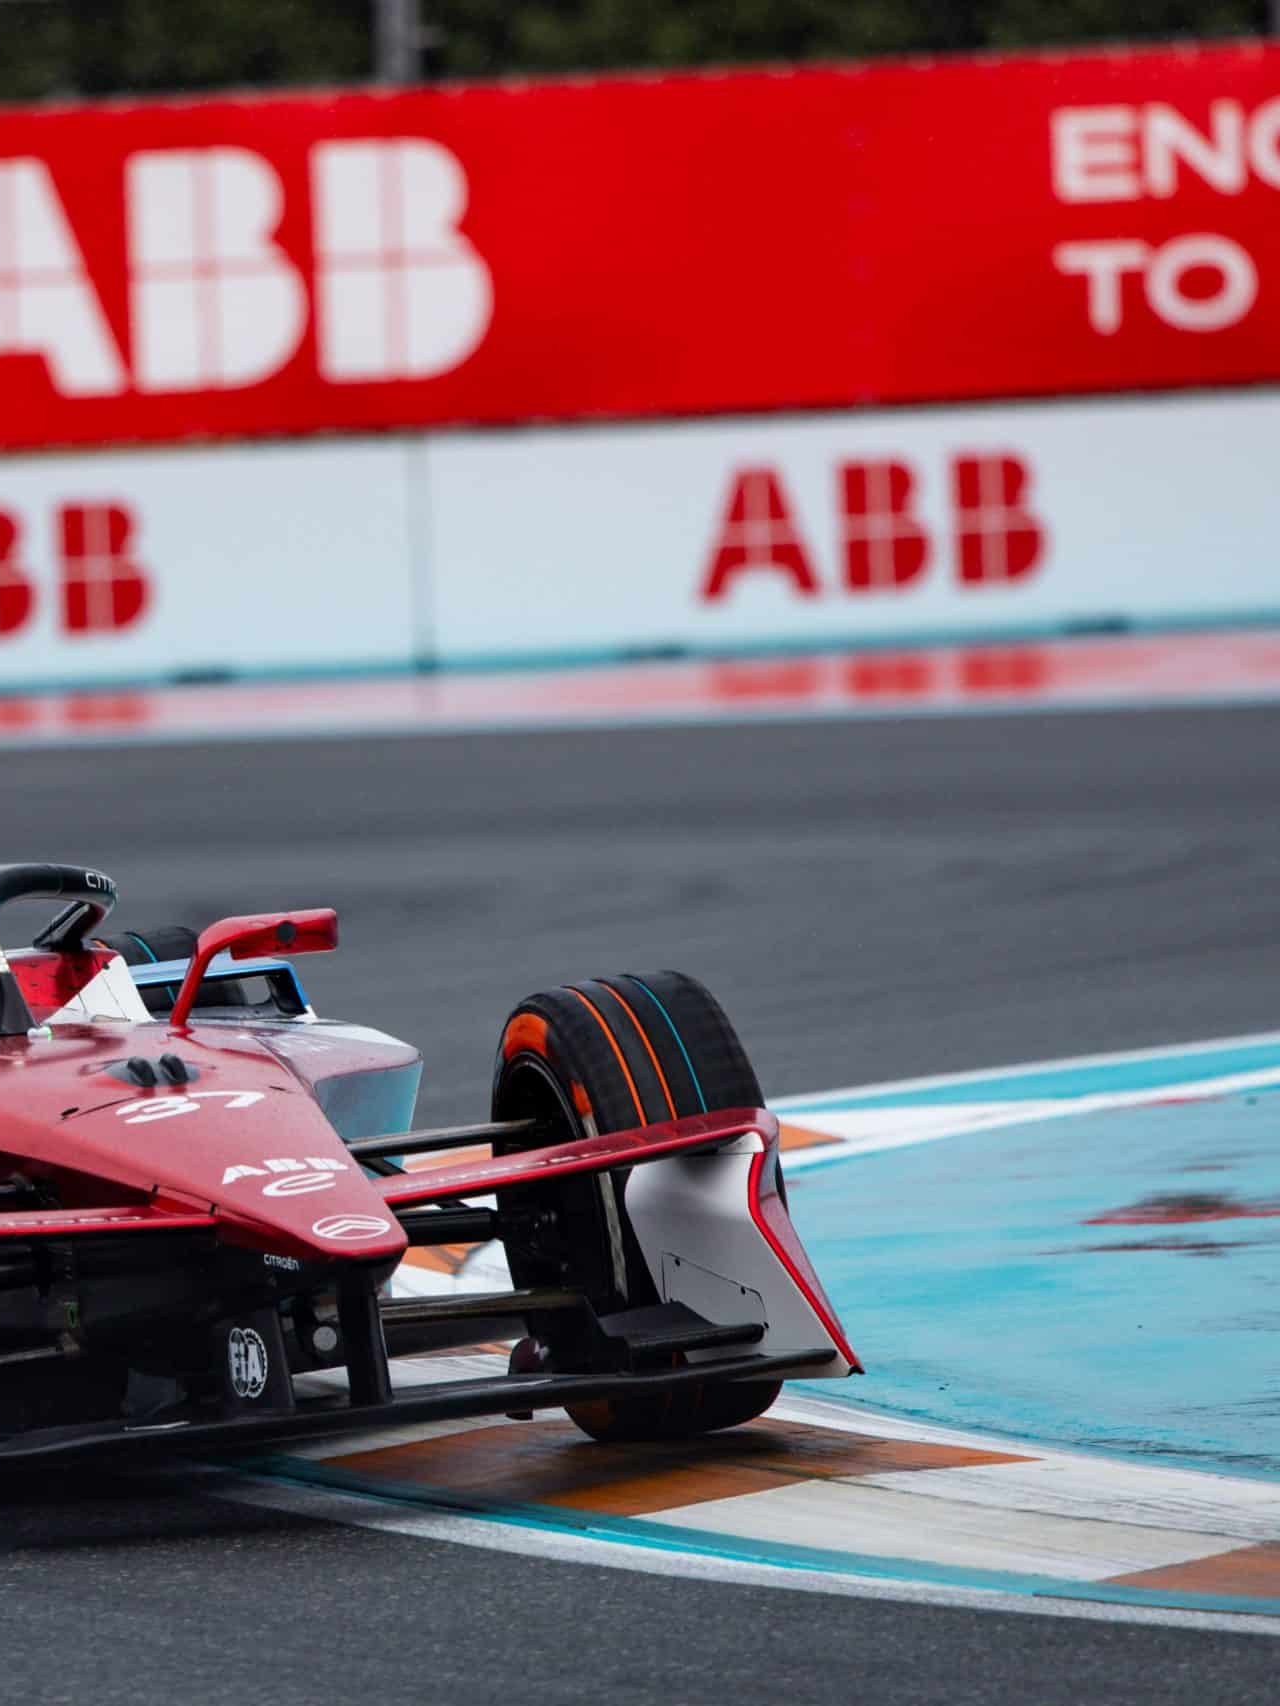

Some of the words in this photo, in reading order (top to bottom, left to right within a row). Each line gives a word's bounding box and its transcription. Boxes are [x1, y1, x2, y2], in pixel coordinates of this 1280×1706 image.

[1055, 233, 1258, 334] TO
[700, 451, 1046, 604] ABB
[115, 1091, 265, 1124] 37
